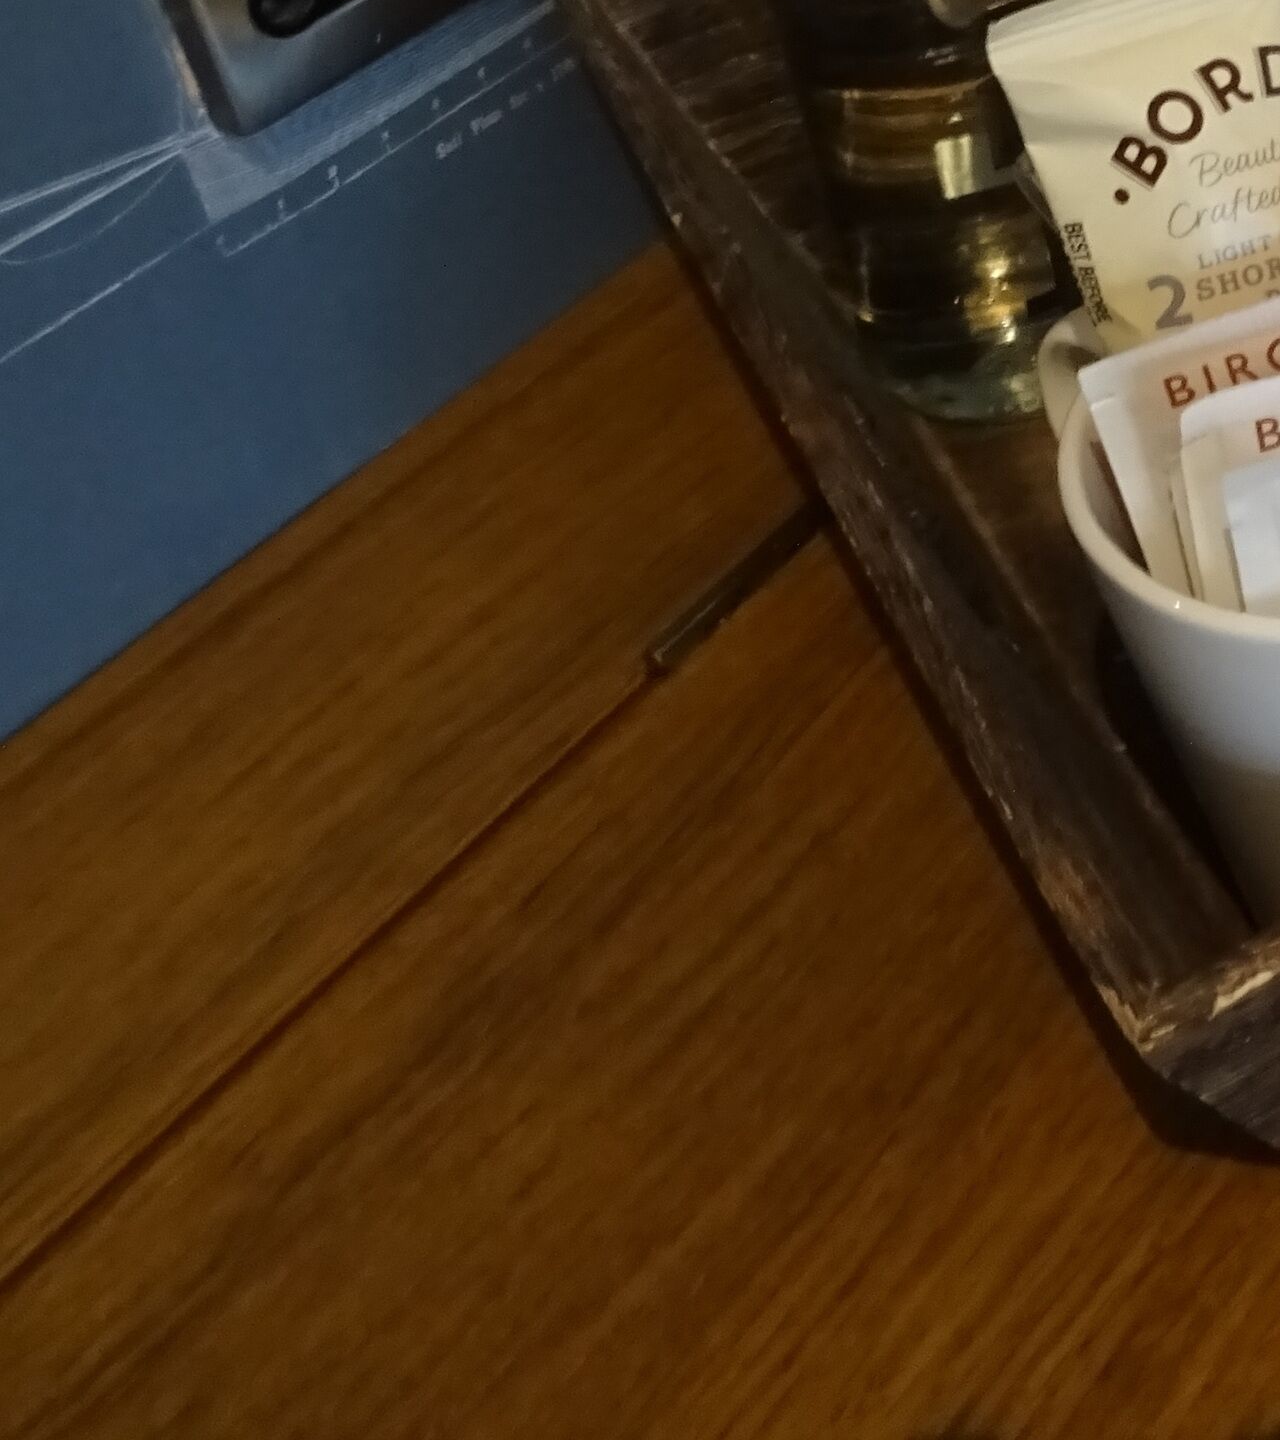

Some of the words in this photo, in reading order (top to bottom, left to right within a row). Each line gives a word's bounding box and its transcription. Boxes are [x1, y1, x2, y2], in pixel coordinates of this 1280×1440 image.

[1064, 222, 1091, 261] BEST
[1197, 228, 1275, 269] LIGHT
[1147, 274, 1194, 329] 2
